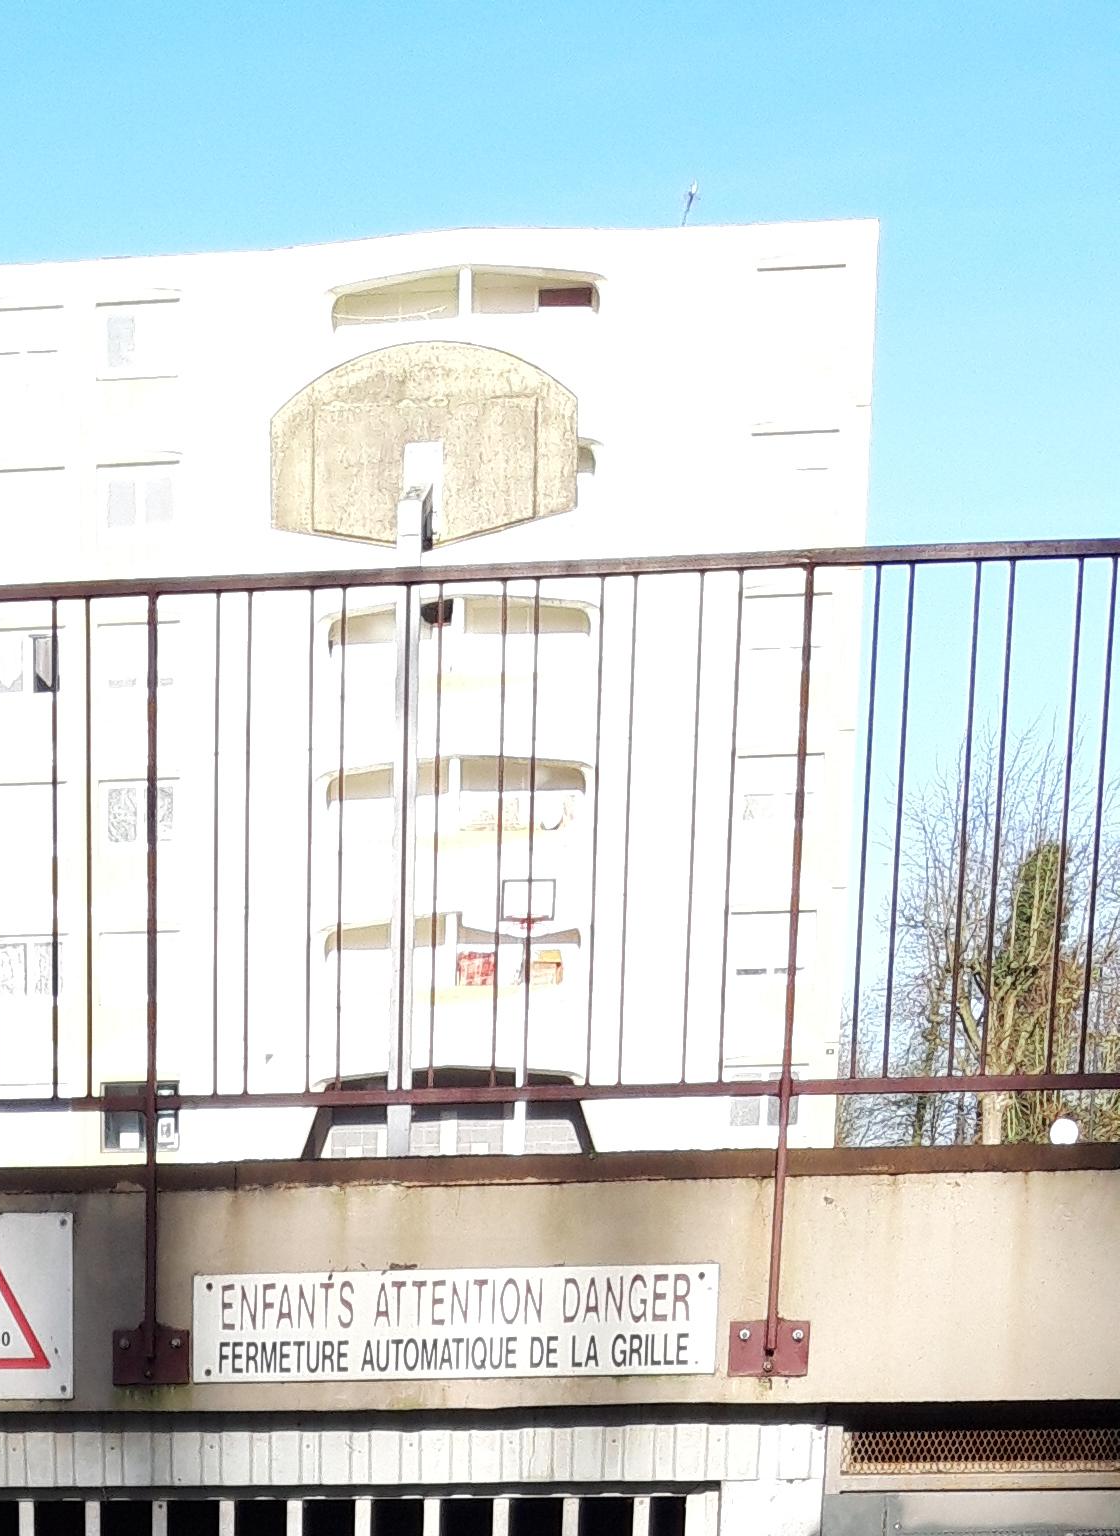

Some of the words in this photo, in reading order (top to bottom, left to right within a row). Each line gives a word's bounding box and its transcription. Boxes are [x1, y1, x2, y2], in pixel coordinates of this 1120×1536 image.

[222, 1280, 354, 1330] ENFANTS
[374, 1277, 543, 1327] ATTENTION
[563, 1273, 691, 1324] DANGER
[218, 1339, 349, 1373] FERMETURE
[360, 1336, 518, 1371] AUTOMATIQUE
[529, 1336, 559, 1368] DE
[571, 1335, 599, 1367] LA
